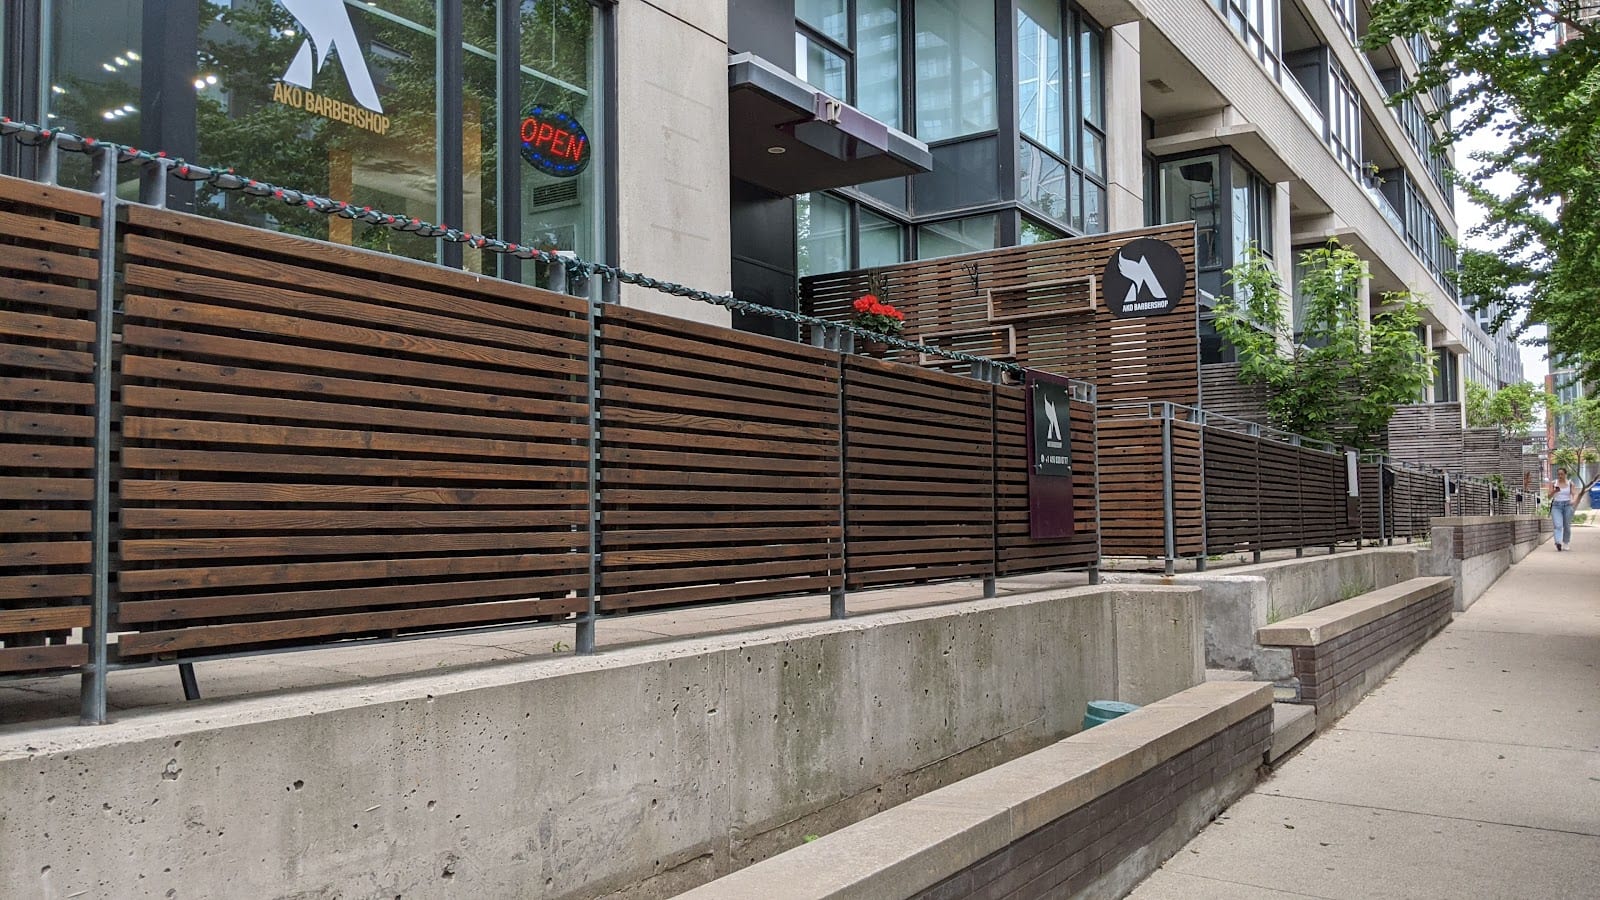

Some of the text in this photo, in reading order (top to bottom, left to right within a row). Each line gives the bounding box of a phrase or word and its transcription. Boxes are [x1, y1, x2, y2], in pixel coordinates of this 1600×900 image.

[273, 82, 390, 135] AKO BARBERSHOP
[520, 118, 585, 161] OPEN
[1122, 300, 1169, 312] AKO BARBERSHOP
